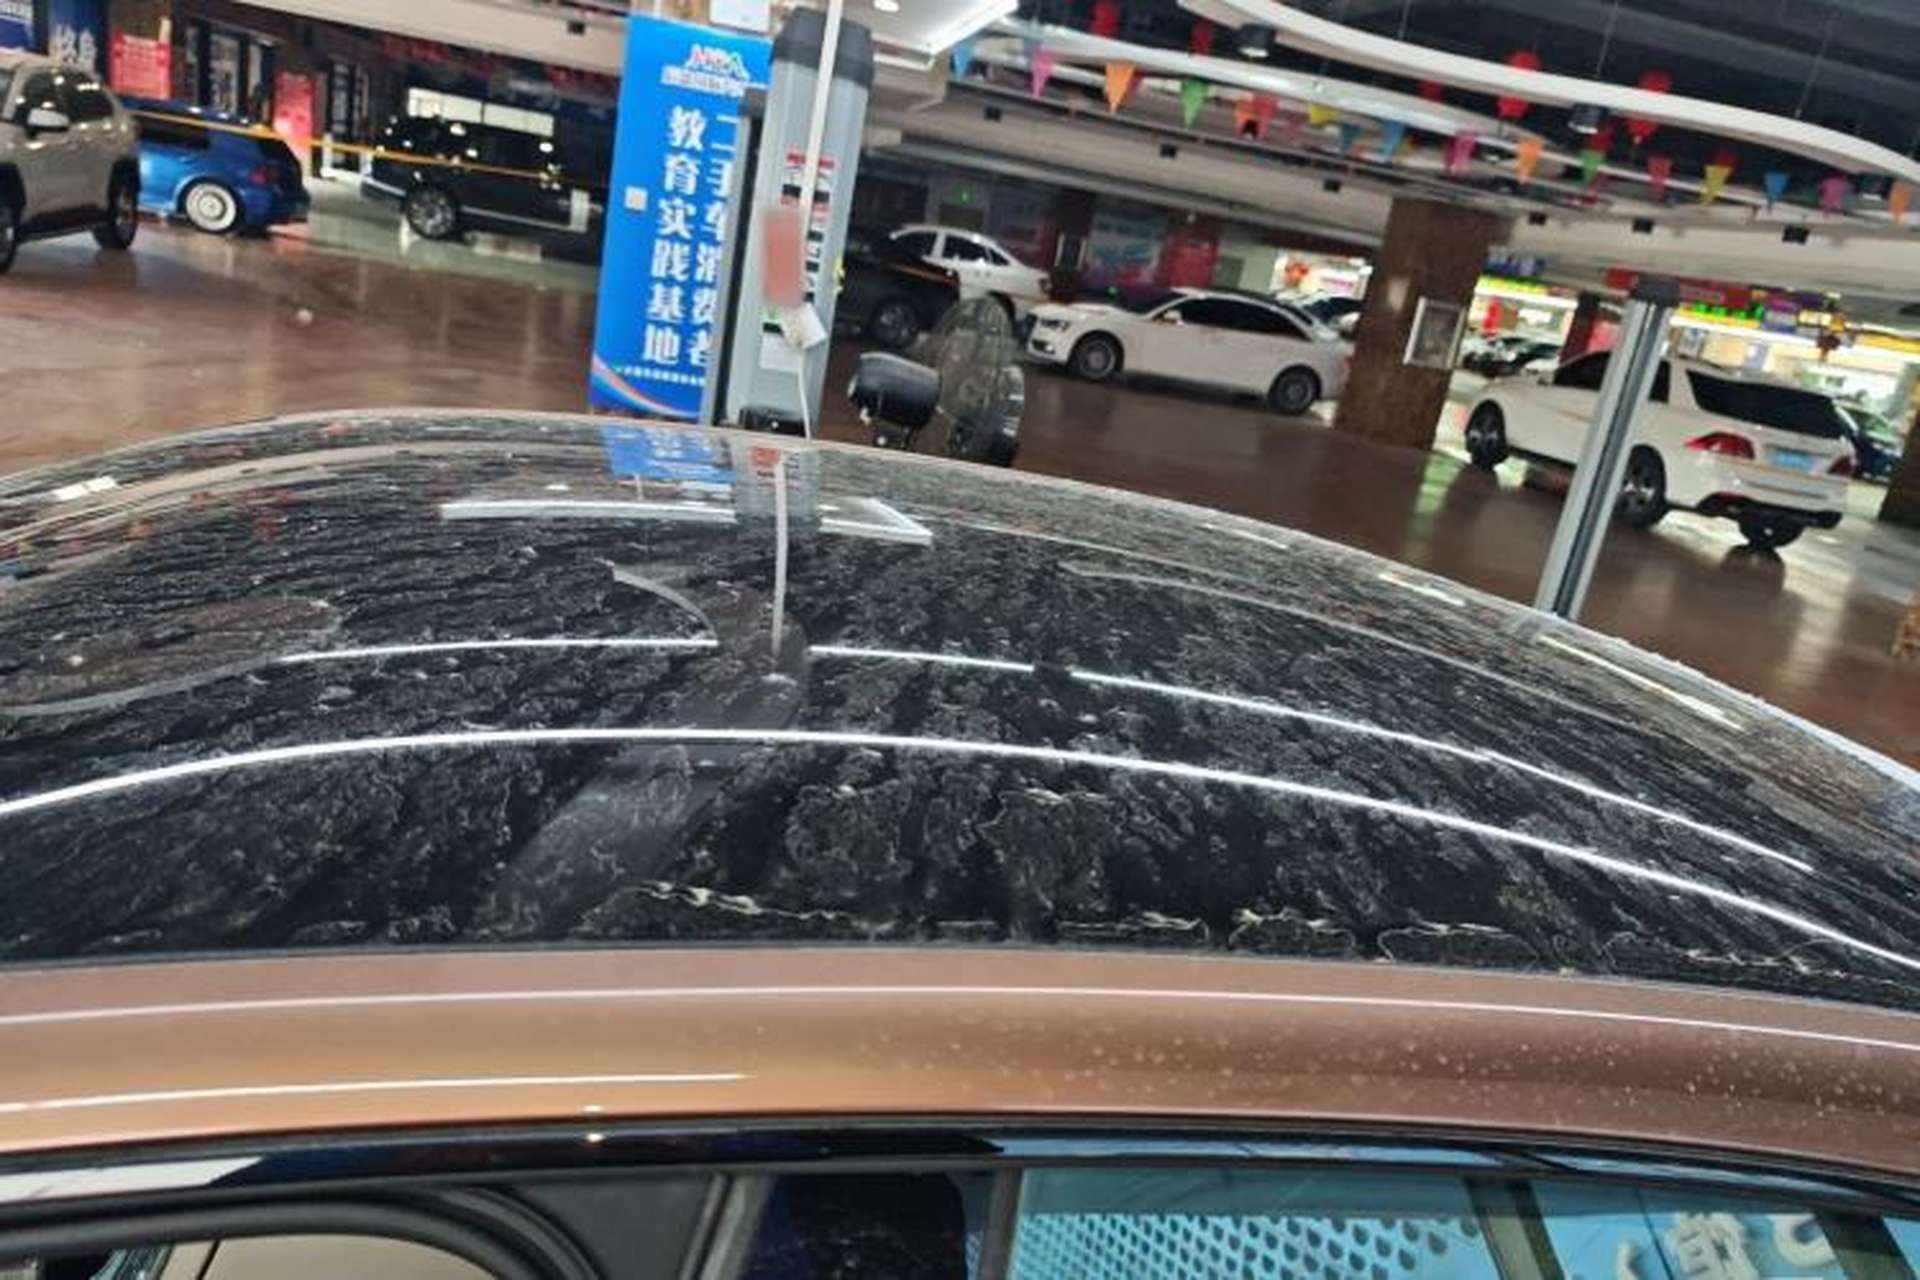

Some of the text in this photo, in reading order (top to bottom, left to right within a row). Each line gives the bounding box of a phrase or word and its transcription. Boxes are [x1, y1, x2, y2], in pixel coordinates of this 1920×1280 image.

[642, 104, 706, 365] 教育实践基地
